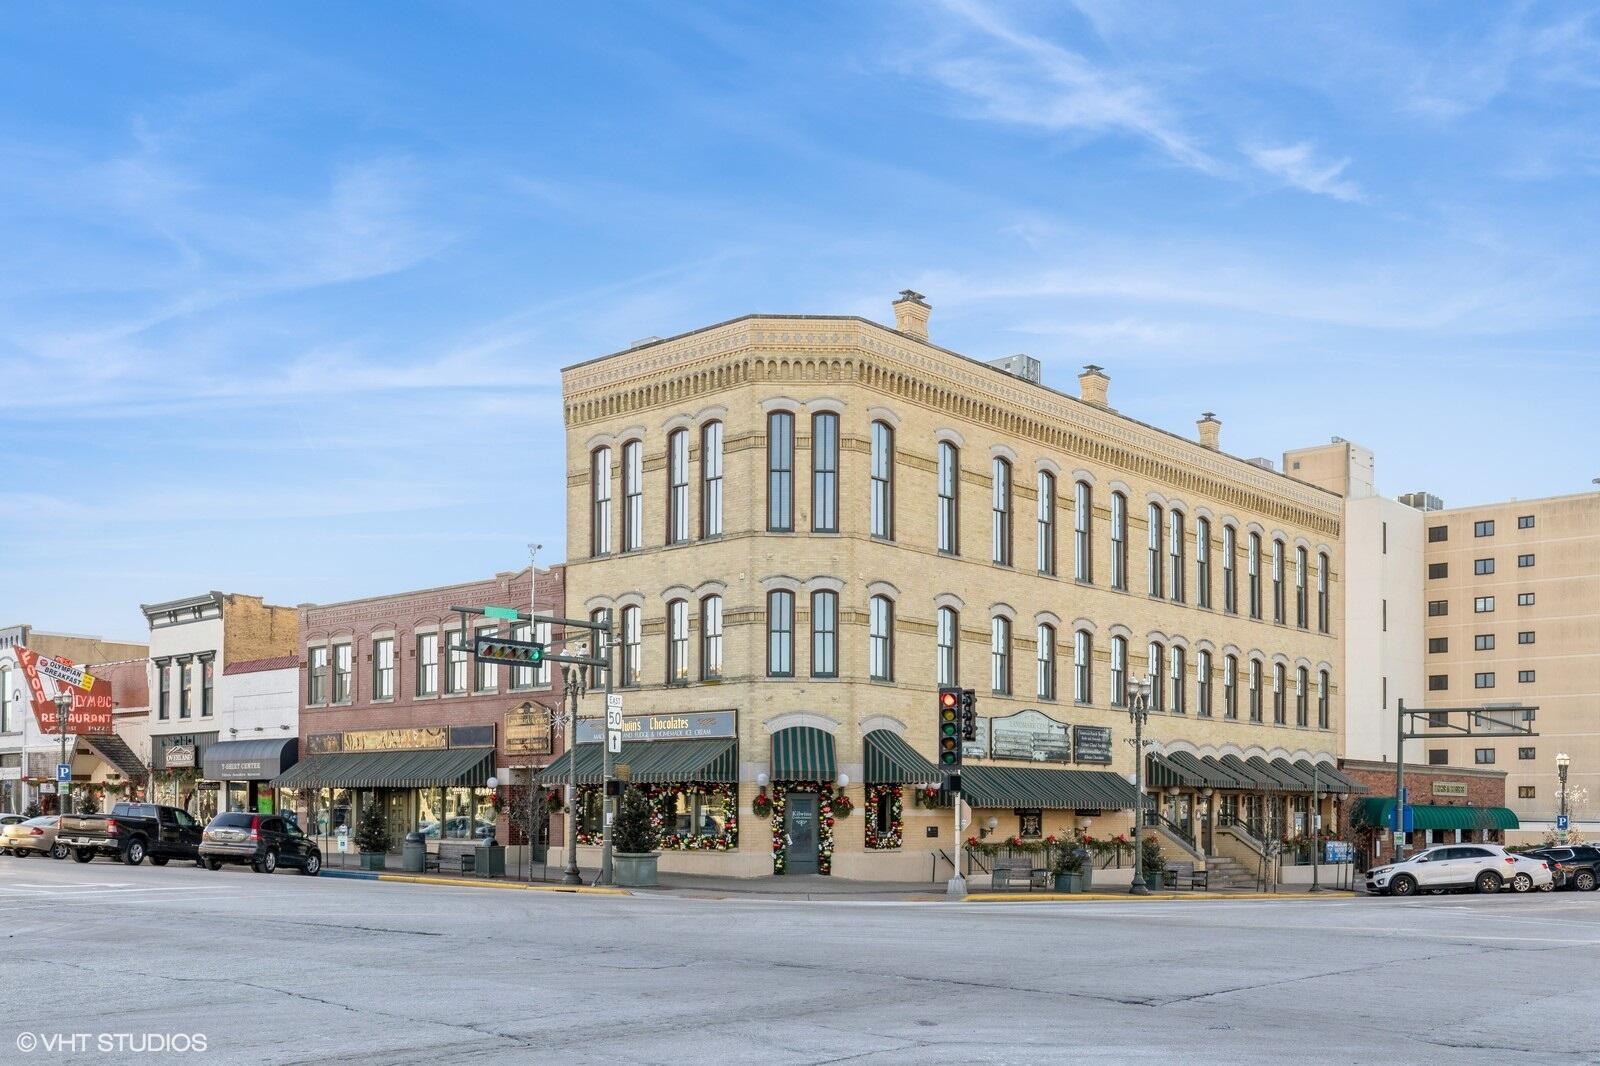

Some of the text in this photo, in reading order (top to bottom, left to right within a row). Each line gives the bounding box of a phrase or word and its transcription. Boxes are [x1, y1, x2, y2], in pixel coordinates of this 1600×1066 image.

[50, 660, 82, 678] OLYMPIAN
[21, 649, 46, 705] FOOD
[44, 666, 82, 686] BREAKFAST
[41, 712, 112, 724] RESAURANT
[609, 711, 621, 725] 50
[649, 717, 689, 730] Chocolates
[60, 767, 69, 778] P
[1559, 817, 1567, 826] P
